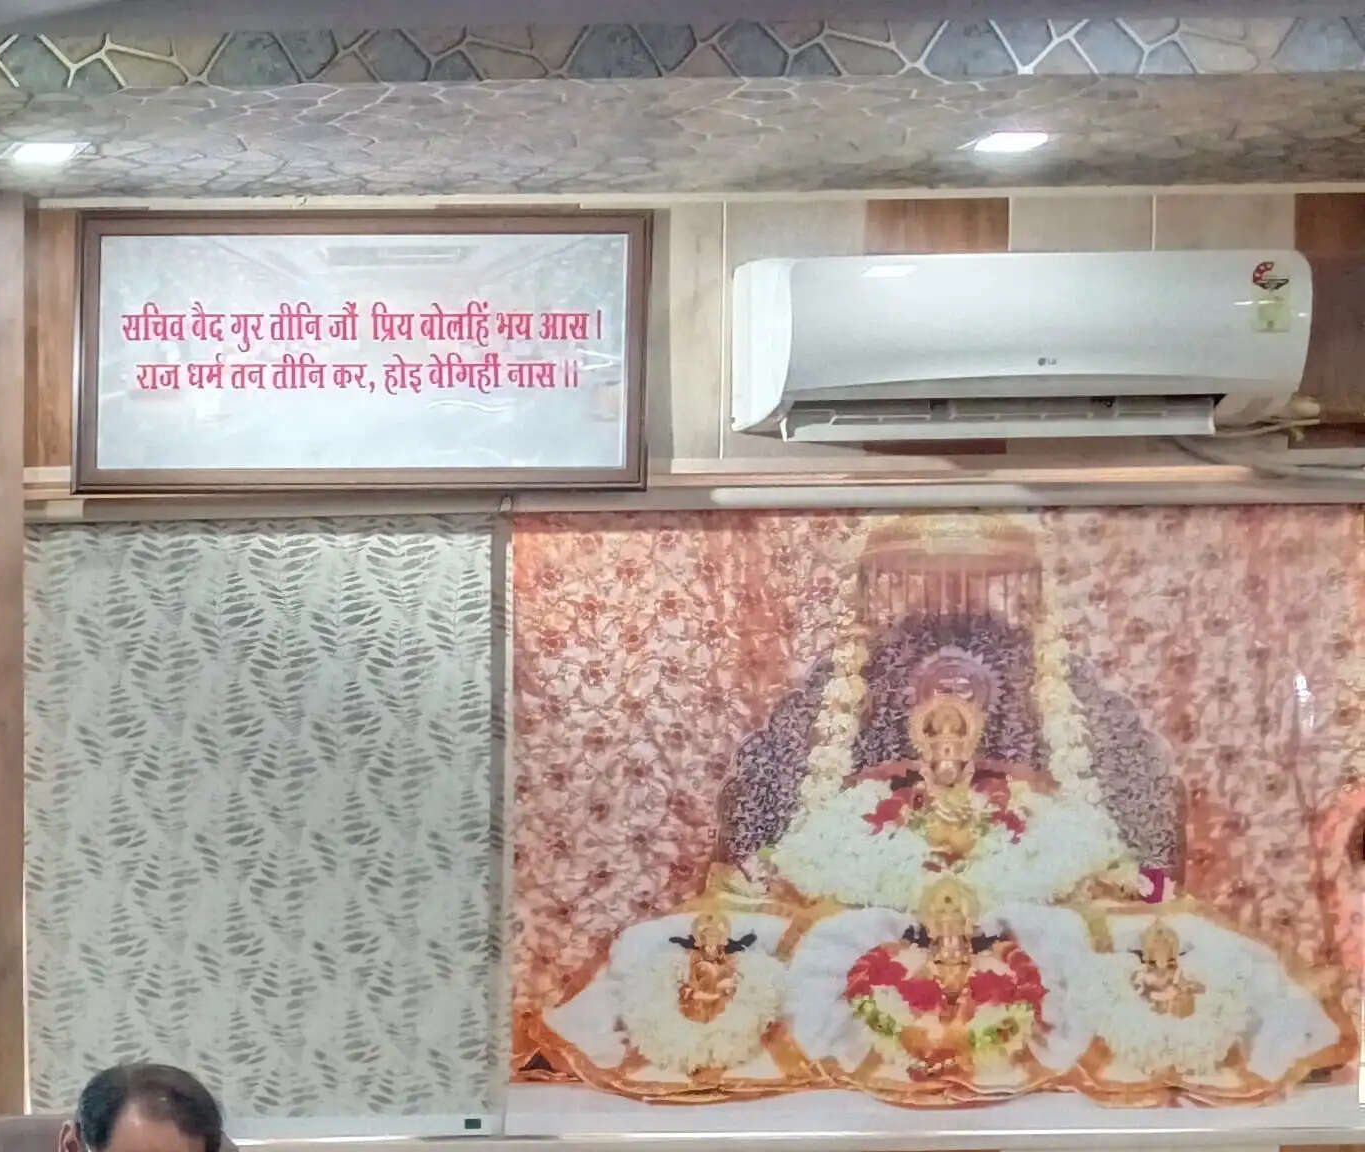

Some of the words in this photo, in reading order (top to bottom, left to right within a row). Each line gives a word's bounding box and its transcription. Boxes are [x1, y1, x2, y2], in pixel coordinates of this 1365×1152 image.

[121, 301, 186, 341] सचिव
[230, 313, 264, 353] गुर
[270, 302, 322, 341] तीनि
[371, 301, 414, 342] प्रिय
[420, 301, 491, 347] बोलहिं
[496, 311, 534, 341] भय
[136, 364, 181, 390] राज
[187, 353, 225, 390] धर्म
[231, 364, 267, 389] तन
[272, 353, 327, 390] तीनि
[382, 353, 423, 395] होइ
